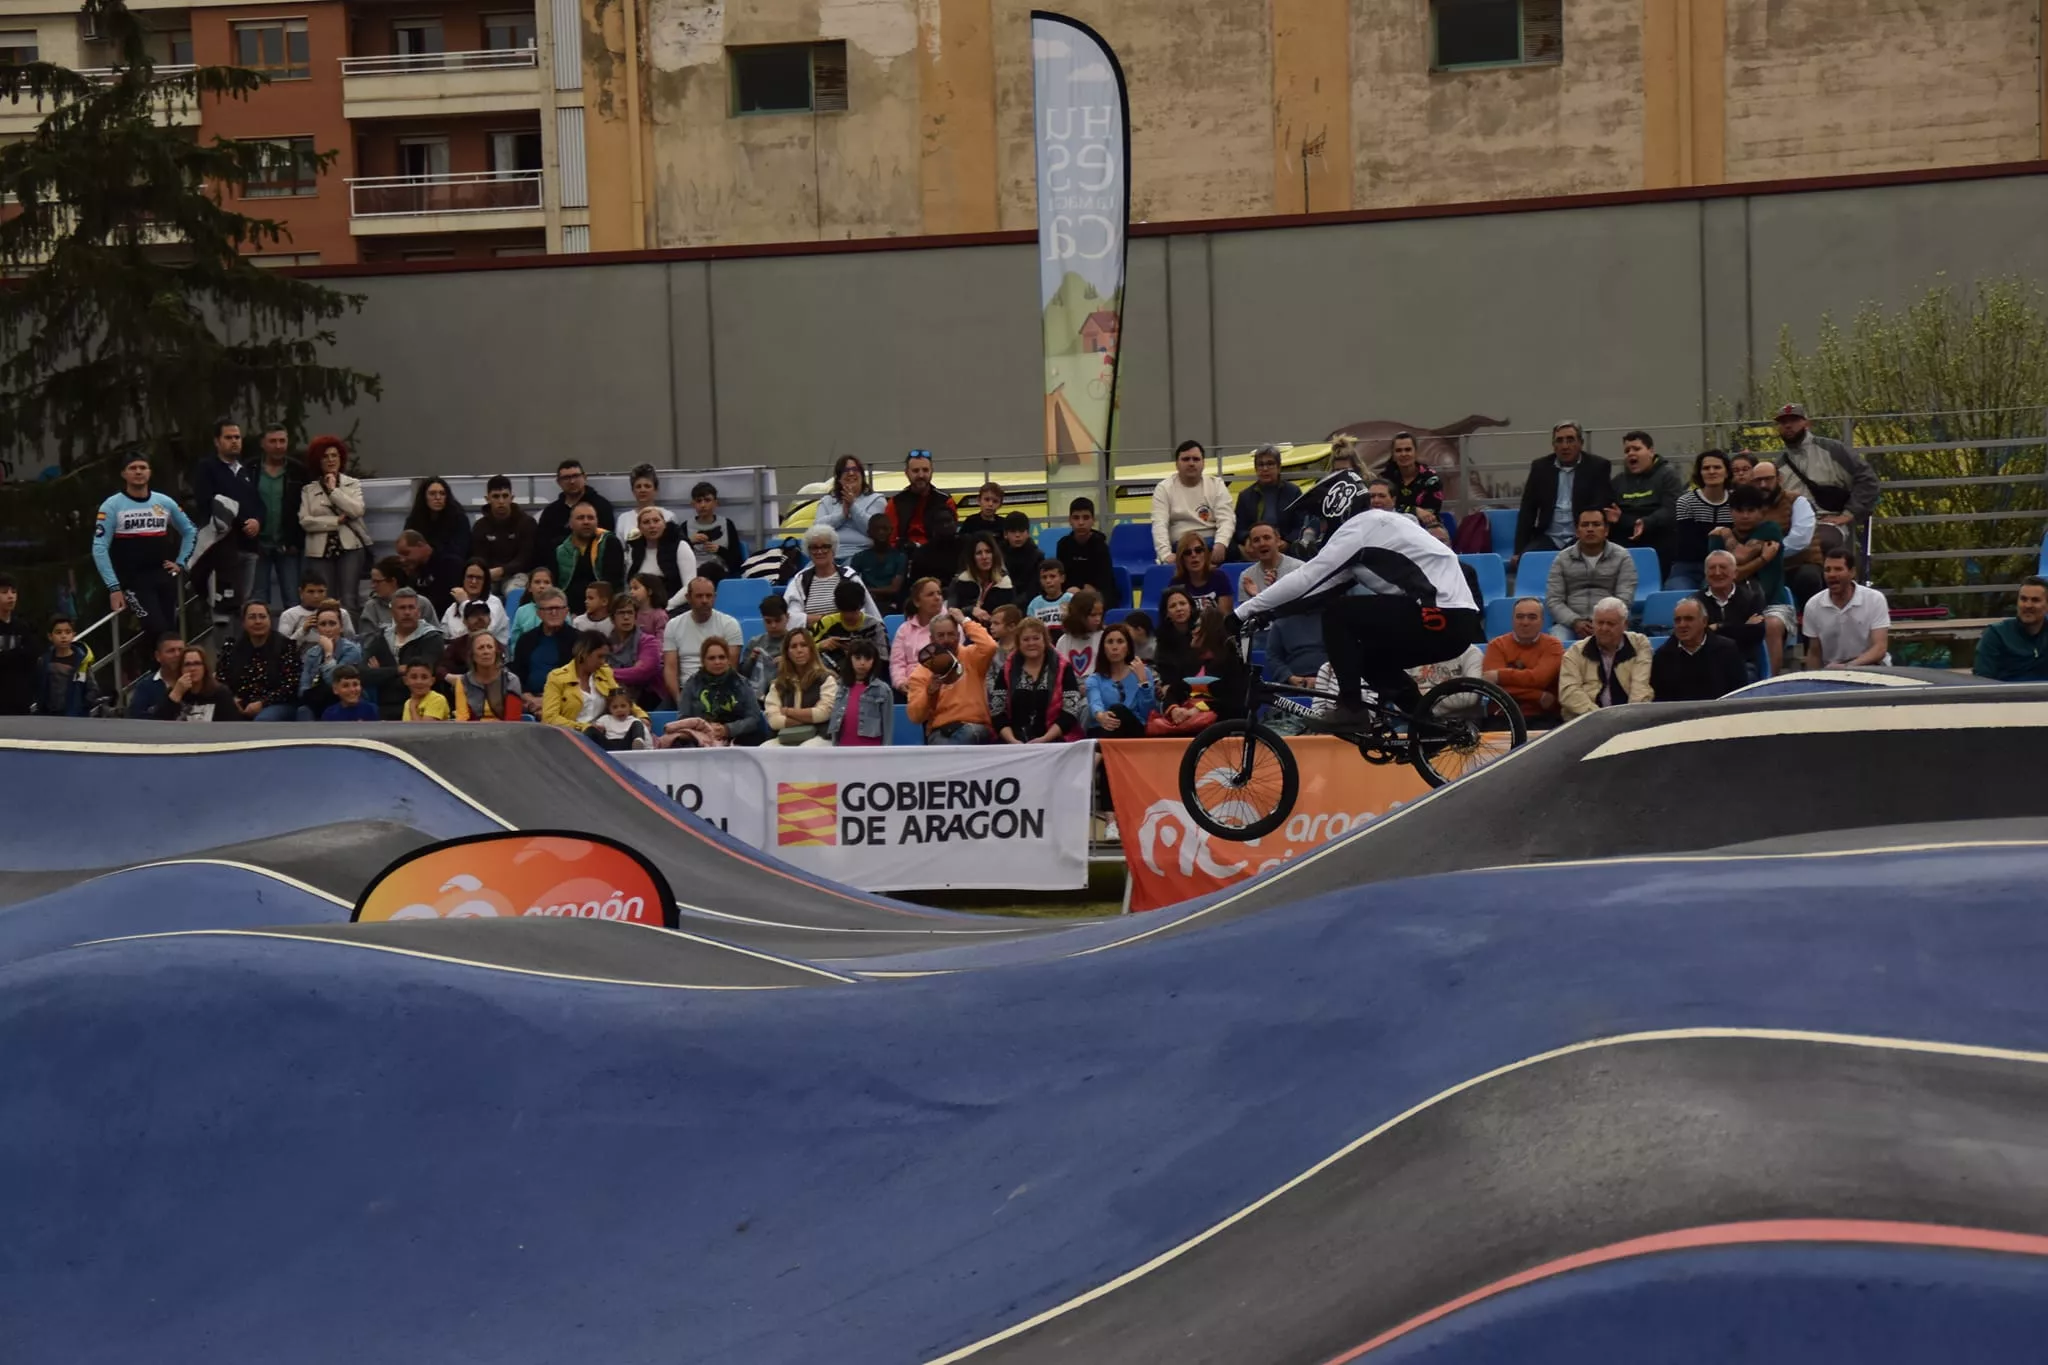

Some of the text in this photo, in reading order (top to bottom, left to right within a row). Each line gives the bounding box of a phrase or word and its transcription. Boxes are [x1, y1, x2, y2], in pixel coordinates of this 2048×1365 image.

[124, 519, 146, 530] BMX
[841, 777, 1021, 812] GOBIERNO
[841, 808, 1044, 845] DE ARAGON
